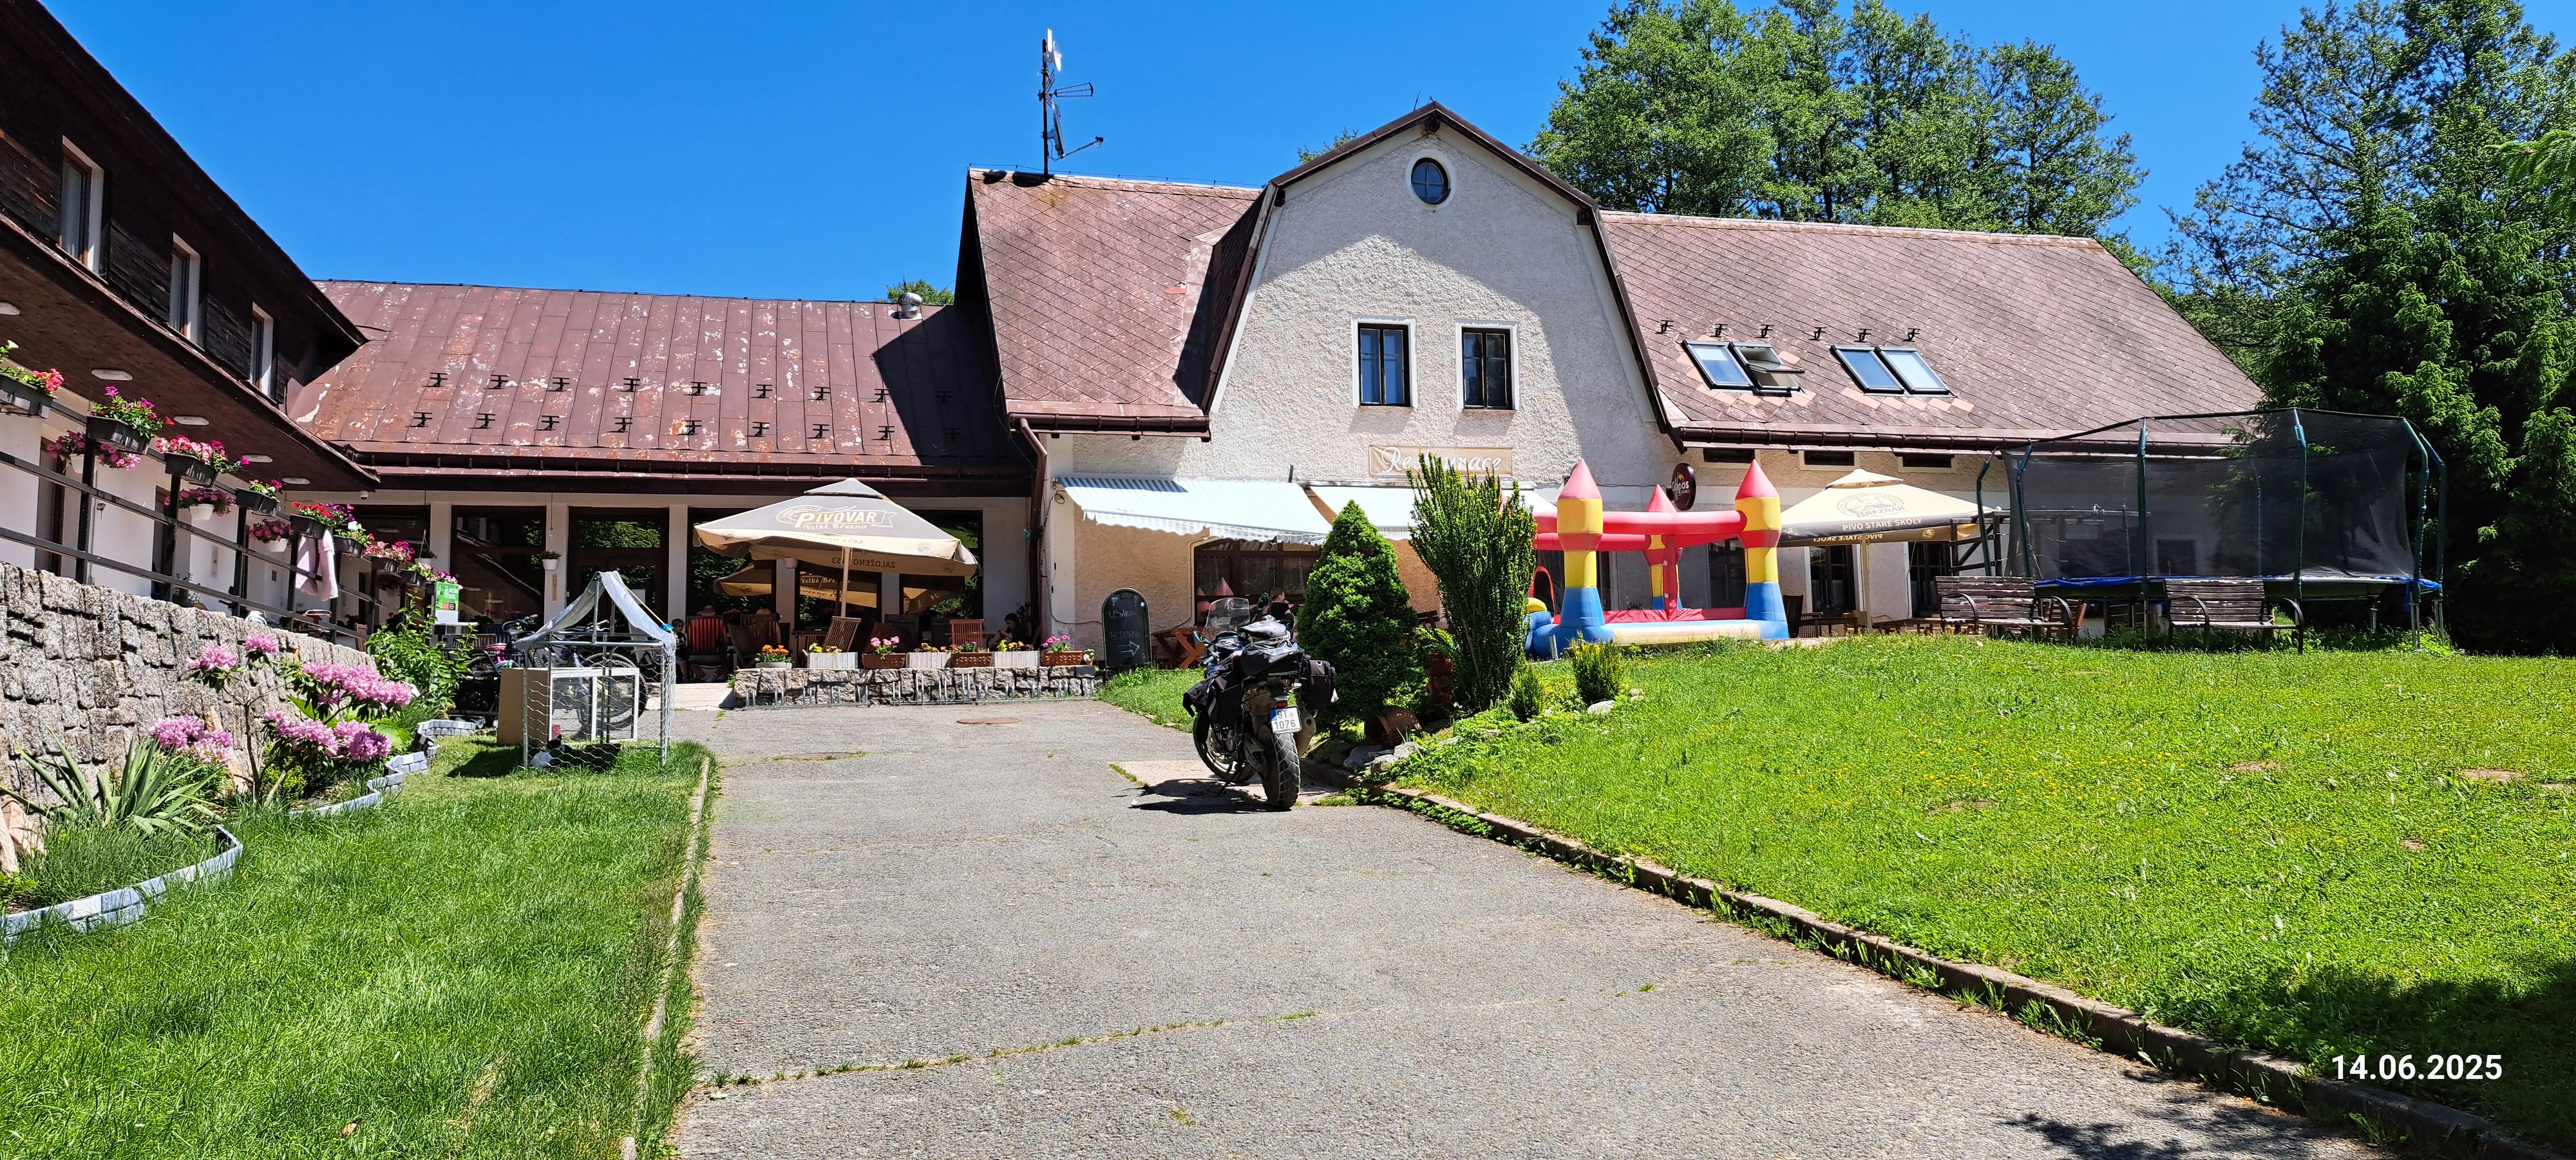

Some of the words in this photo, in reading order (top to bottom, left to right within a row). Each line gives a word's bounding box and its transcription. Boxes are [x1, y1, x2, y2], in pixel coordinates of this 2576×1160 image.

[794, 511, 877, 528] PIVOVAR
[1842, 522, 1863, 531] PIVO
[1866, 518, 1893, 529] STARÉ
[1895, 517, 1922, 526] ŠKOLY
[1274, 719, 1296, 729] 1076
